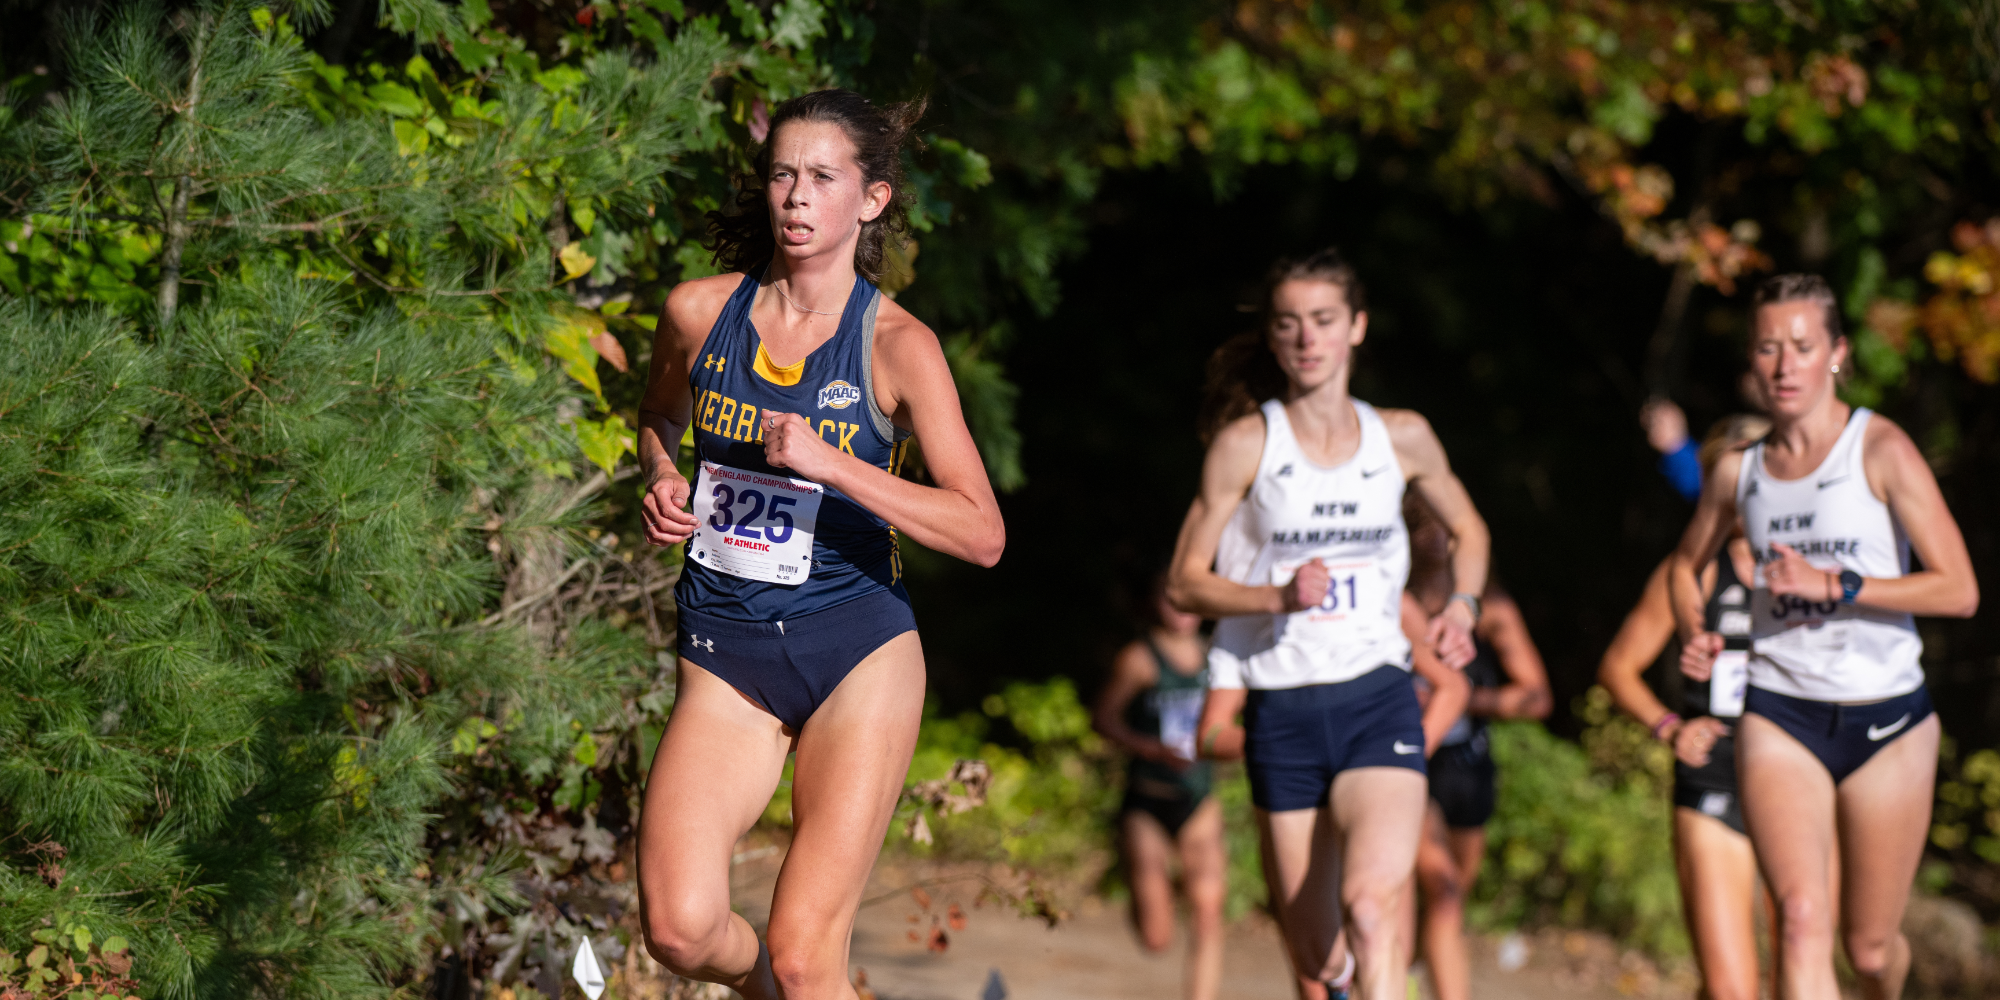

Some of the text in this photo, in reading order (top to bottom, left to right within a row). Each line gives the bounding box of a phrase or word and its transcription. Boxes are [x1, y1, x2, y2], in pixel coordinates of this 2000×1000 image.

[819, 385, 860, 407] MAAC
[693, 386, 860, 457] MERRICK
[706, 466, 813, 496] NEW ENGLAND CHAMPIONSHIPS
[709, 483, 797, 544] 325
[1311, 502, 1358, 517] NEW
[1768, 511, 1816, 533] NEW
[734, 538, 770, 552] ATHLETIC
[1272, 526, 1394, 544] HAMPSHIRE
[1753, 539, 1860, 563] AMSHIRE
